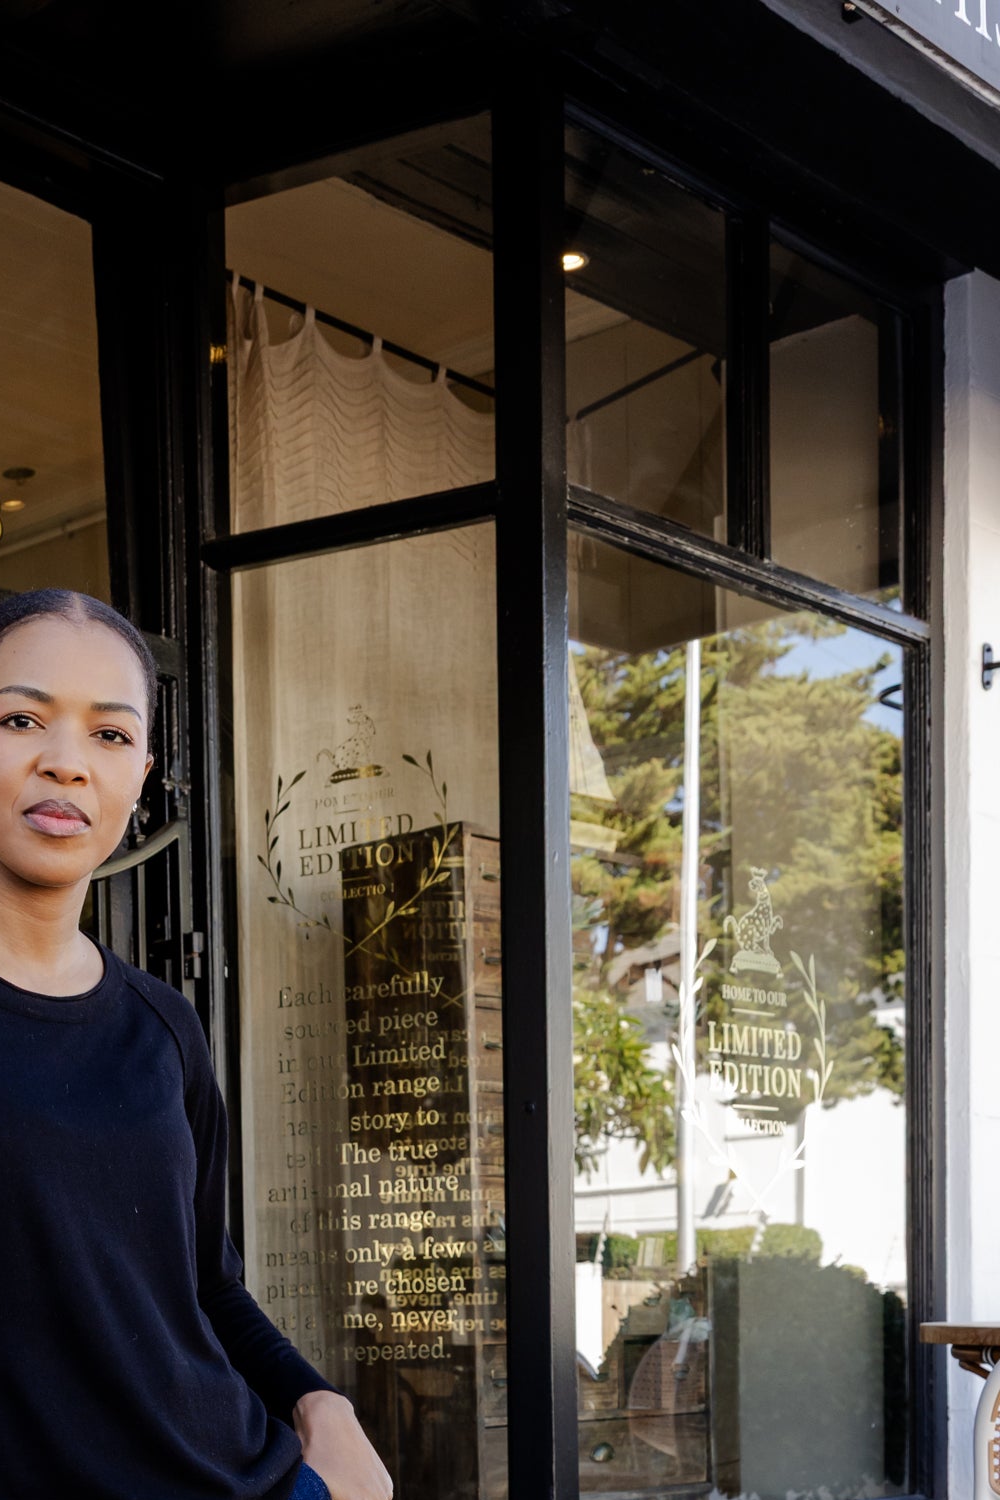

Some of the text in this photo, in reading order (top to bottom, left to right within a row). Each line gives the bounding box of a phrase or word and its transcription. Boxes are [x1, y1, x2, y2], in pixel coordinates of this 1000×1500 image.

[298, 813, 413, 850] LIMITED
[300, 840, 414, 877] EDITION
[278, 970, 445, 1008] Each carefully
[722, 984, 787, 1007] HOME TO OUR
[378, 1008, 439, 1036] piece
[353, 1037, 447, 1067] Limited
[708, 1021, 801, 1060] LIMITED
[281, 1080, 365, 1104] Edition
[372, 1076, 441, 1098] range
[709, 1060, 801, 1098] EDITION
[351, 1109, 410, 1133] story
[416, 1105, 440, 1125] to
[336, 1142, 381, 1166] The
[388, 1141, 438, 1161] true
[378, 1173, 459, 1196] nature
[368, 1209, 437, 1232] range
[345, 1240, 396, 1266] only
[402, 1243, 416, 1261] a
[423, 1236, 466, 1259] few
[385, 1271, 466, 1294] chosen
[391, 1309, 458, 1327] never
[343, 1336, 452, 1365] repeated.
